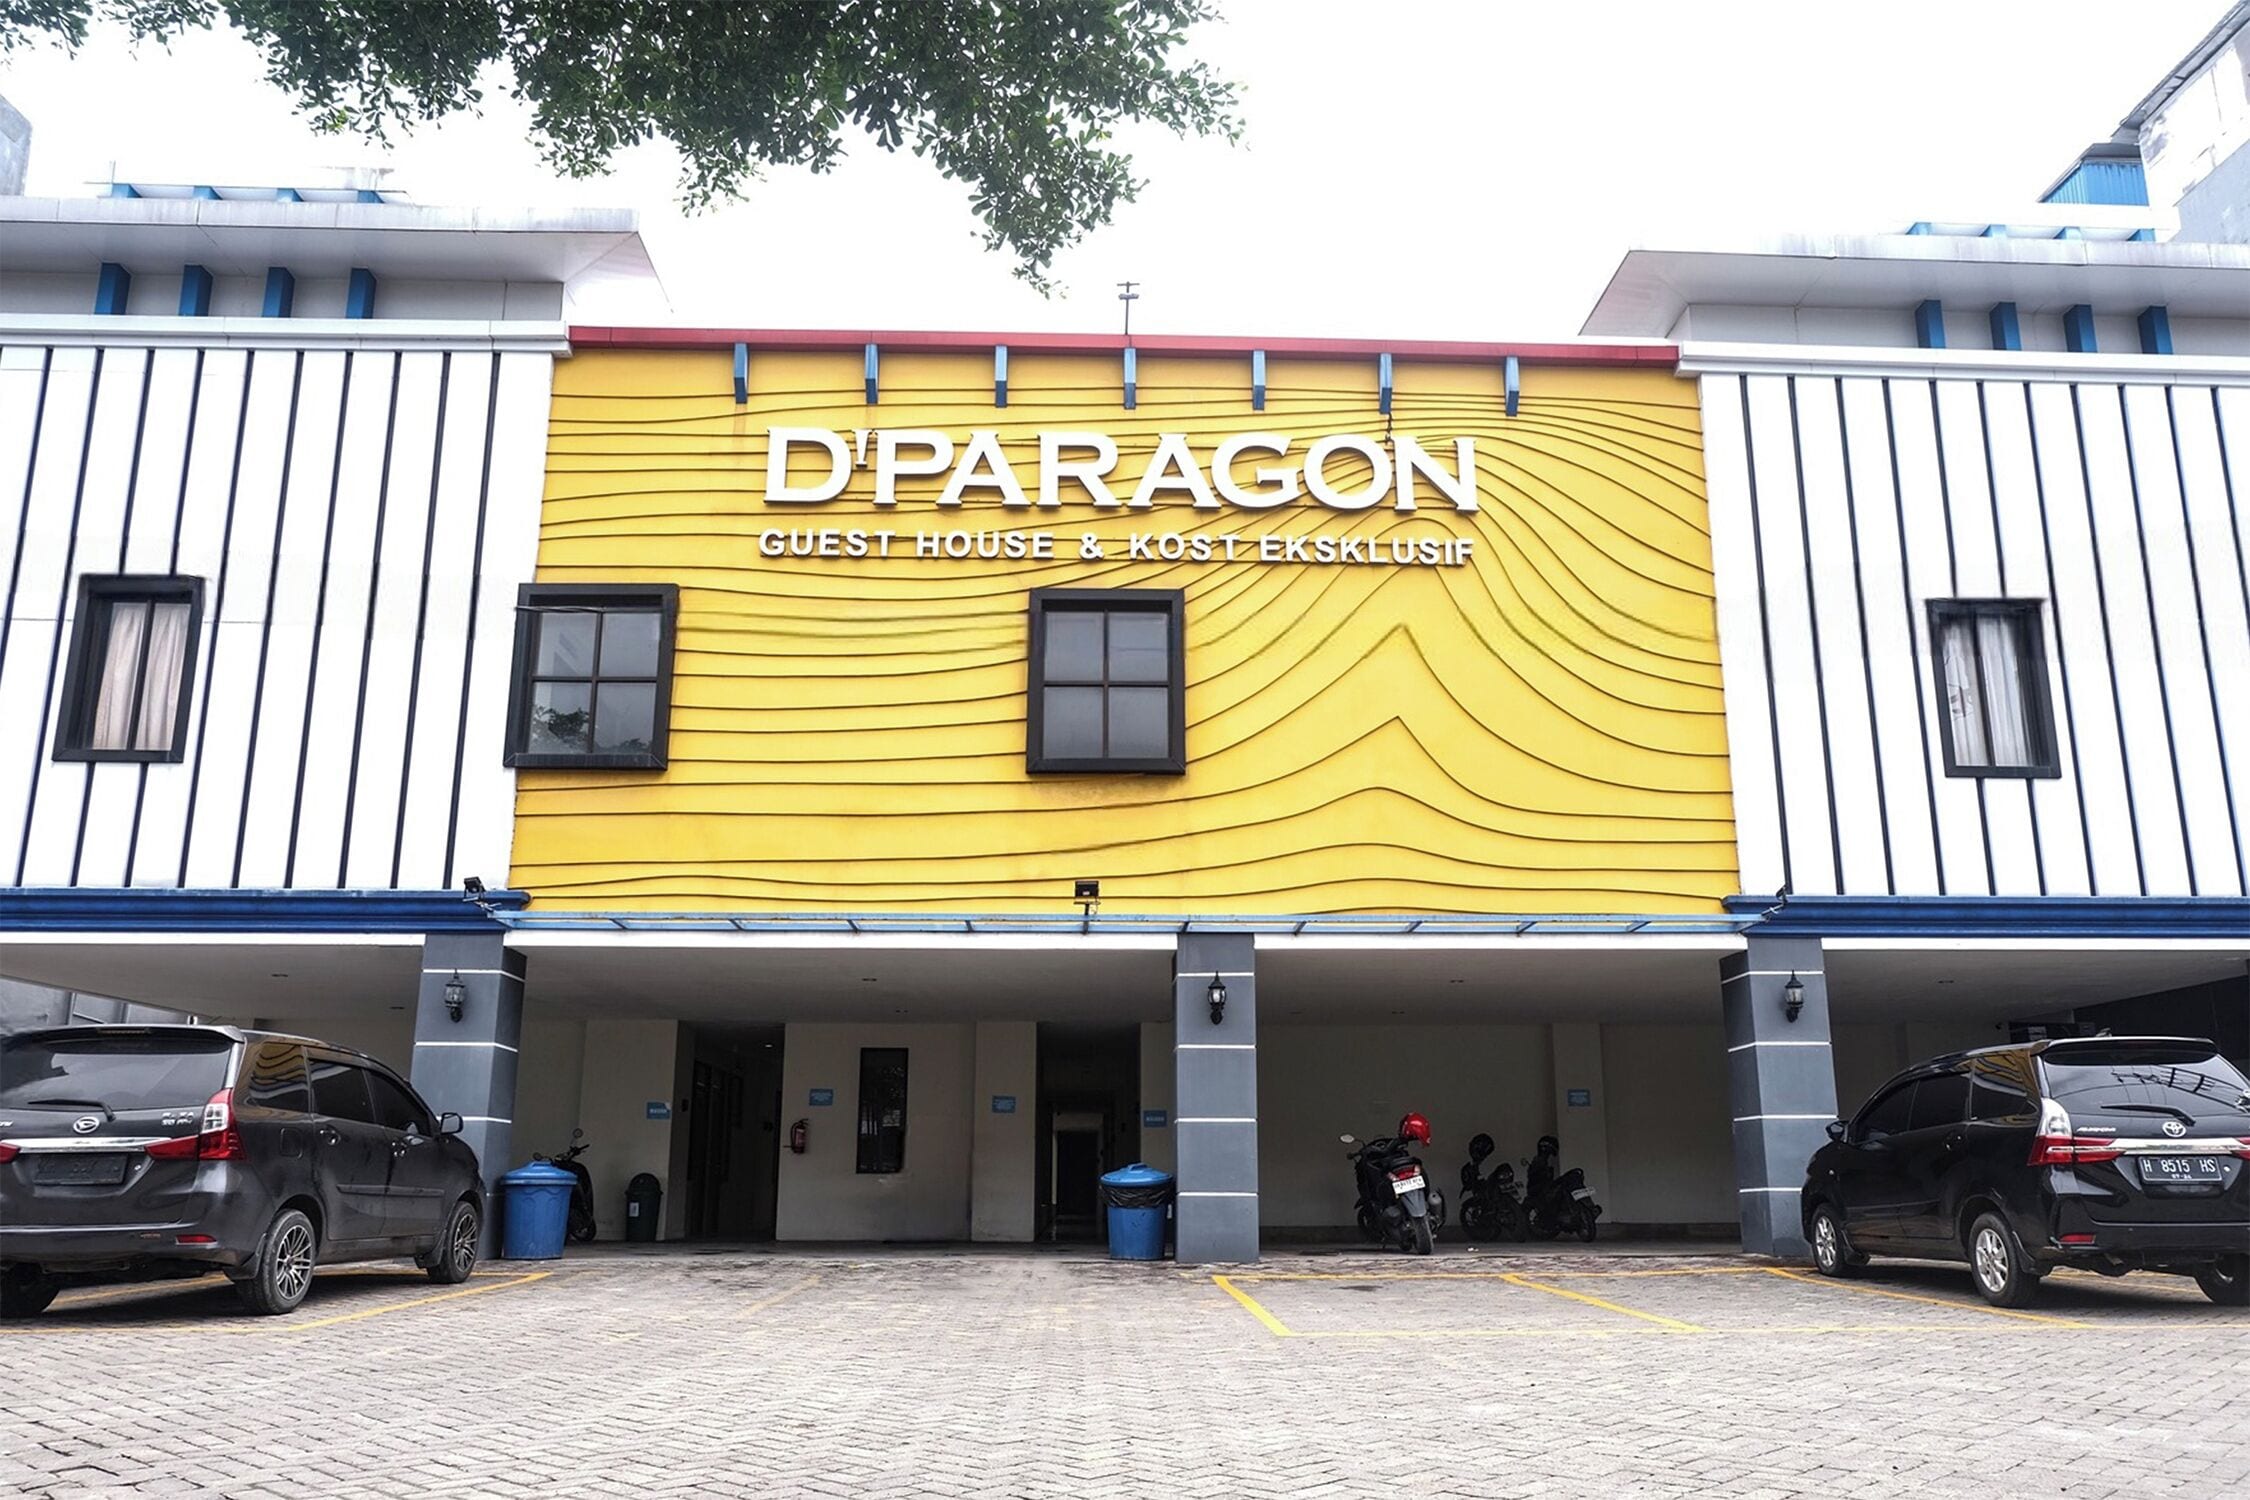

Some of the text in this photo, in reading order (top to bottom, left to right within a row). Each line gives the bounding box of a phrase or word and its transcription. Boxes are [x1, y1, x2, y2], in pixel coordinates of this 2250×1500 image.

[763, 427, 1480, 512] D'PARAGON
[759, 528, 1475, 566] GUEST HOUSE & KOST EKSKLUSIF
[2143, 1159, 2216, 1173] H 8515 HS
